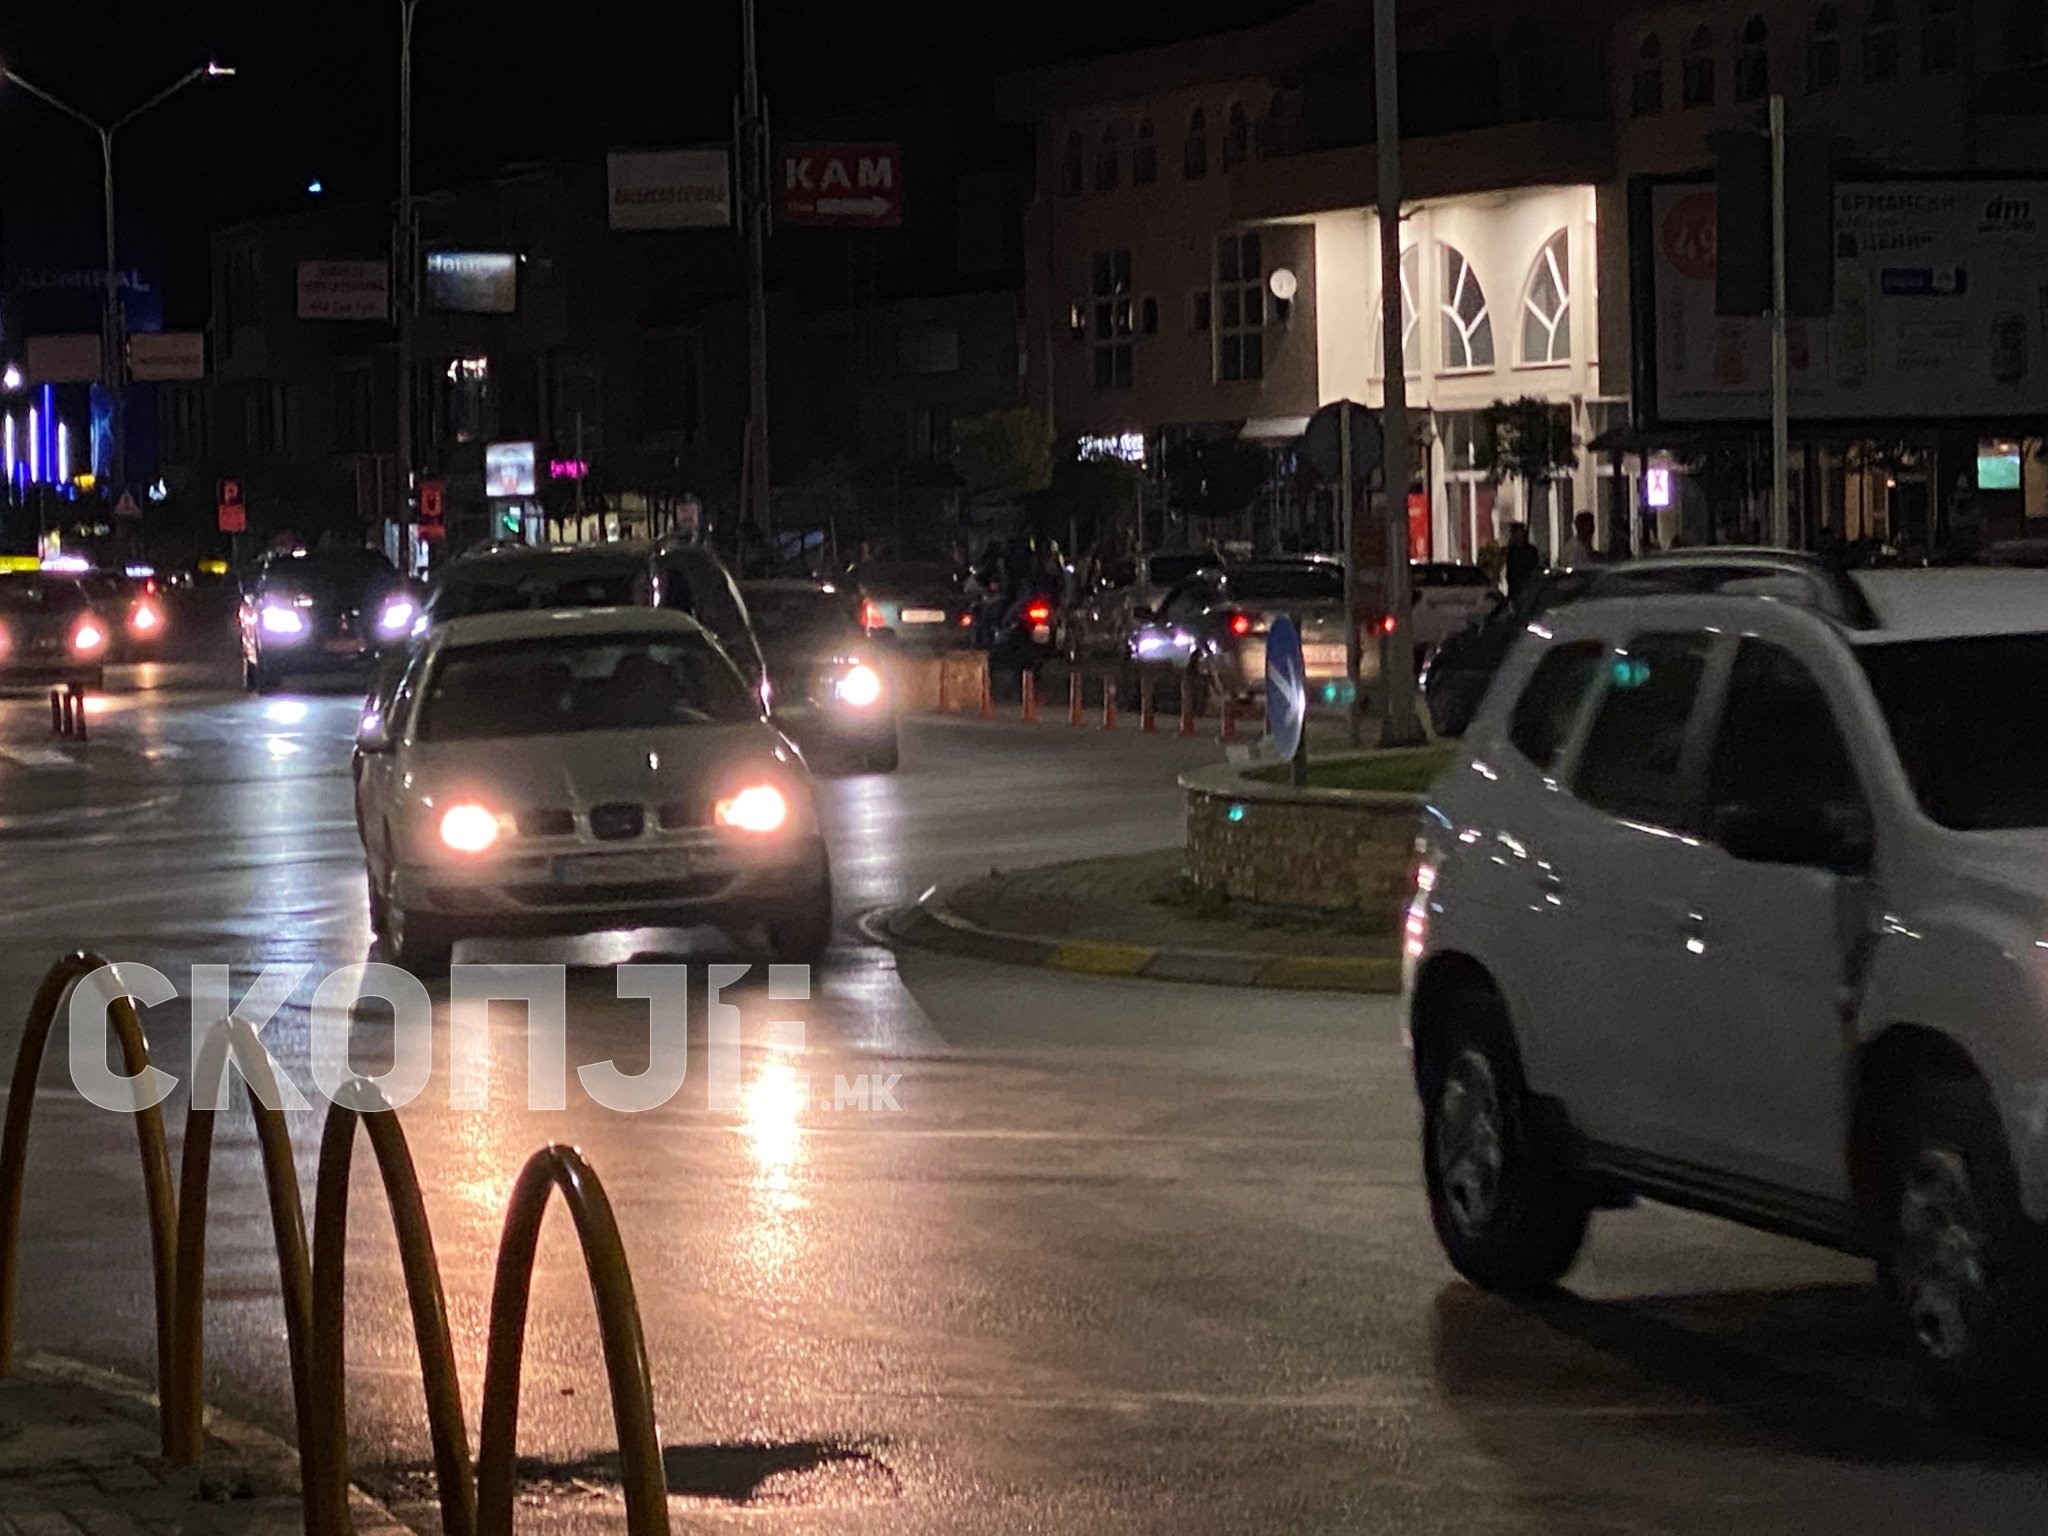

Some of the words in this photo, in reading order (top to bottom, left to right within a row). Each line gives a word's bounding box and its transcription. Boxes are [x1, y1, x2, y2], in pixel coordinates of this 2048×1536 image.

[785, 156, 892, 192] КАМ
[1841, 193, 1955, 212] ЕРМАНСКИ
[1986, 194, 2030, 219] dm
